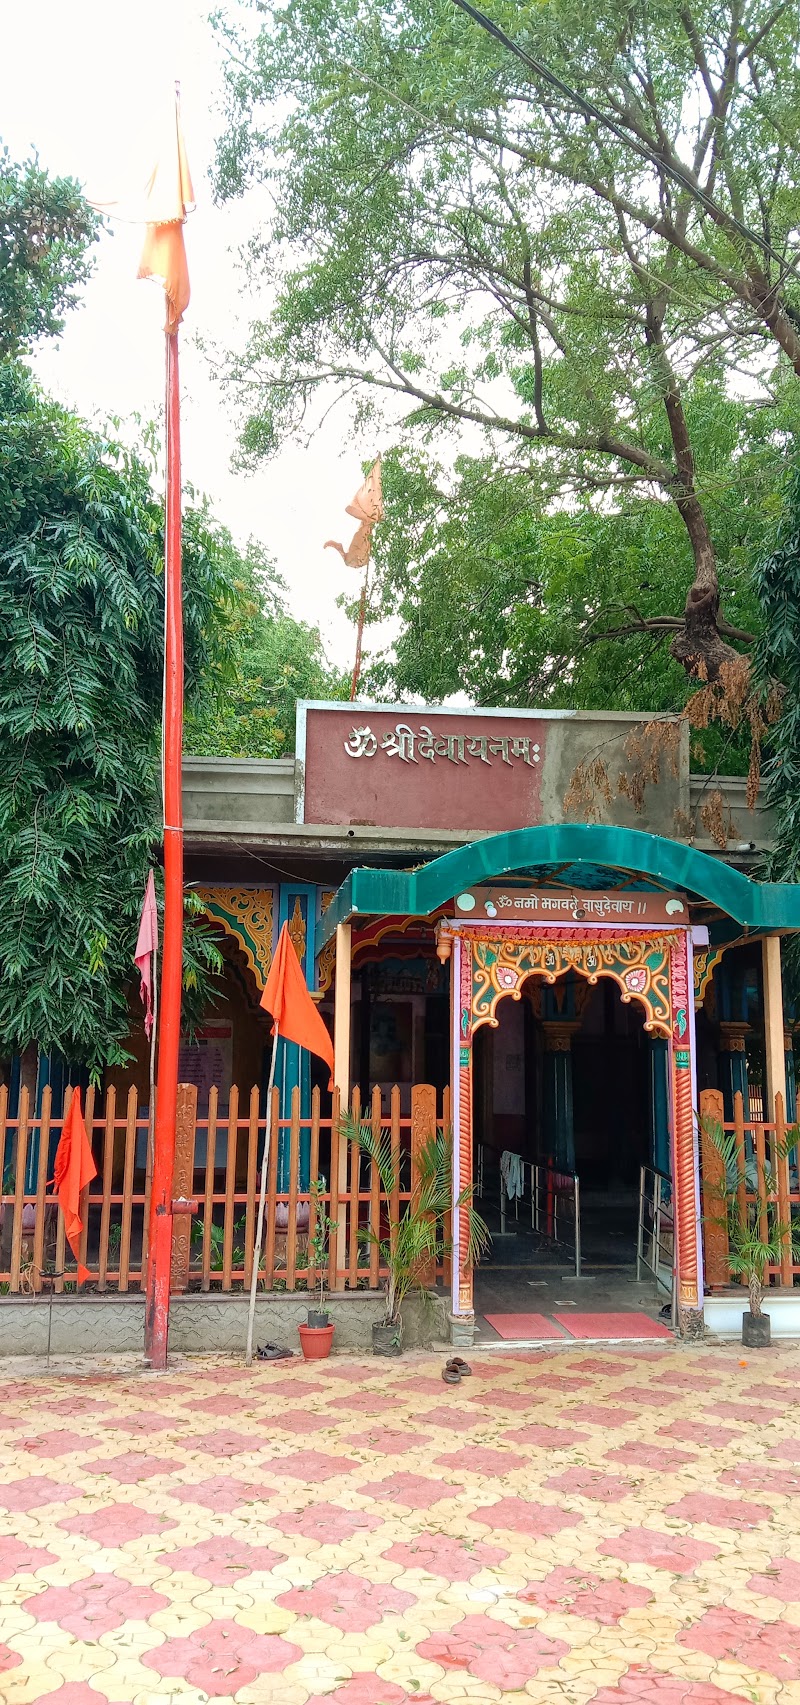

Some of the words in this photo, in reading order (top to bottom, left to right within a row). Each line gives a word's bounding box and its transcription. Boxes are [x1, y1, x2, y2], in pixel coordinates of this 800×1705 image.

[344, 725, 378, 758] ॐ
[496, 895, 513, 908] ॐ
[513, 894, 539, 909] नमो
[541, 895, 578, 911] भगवते
[581, 896, 635, 917] वासुदेवाय
